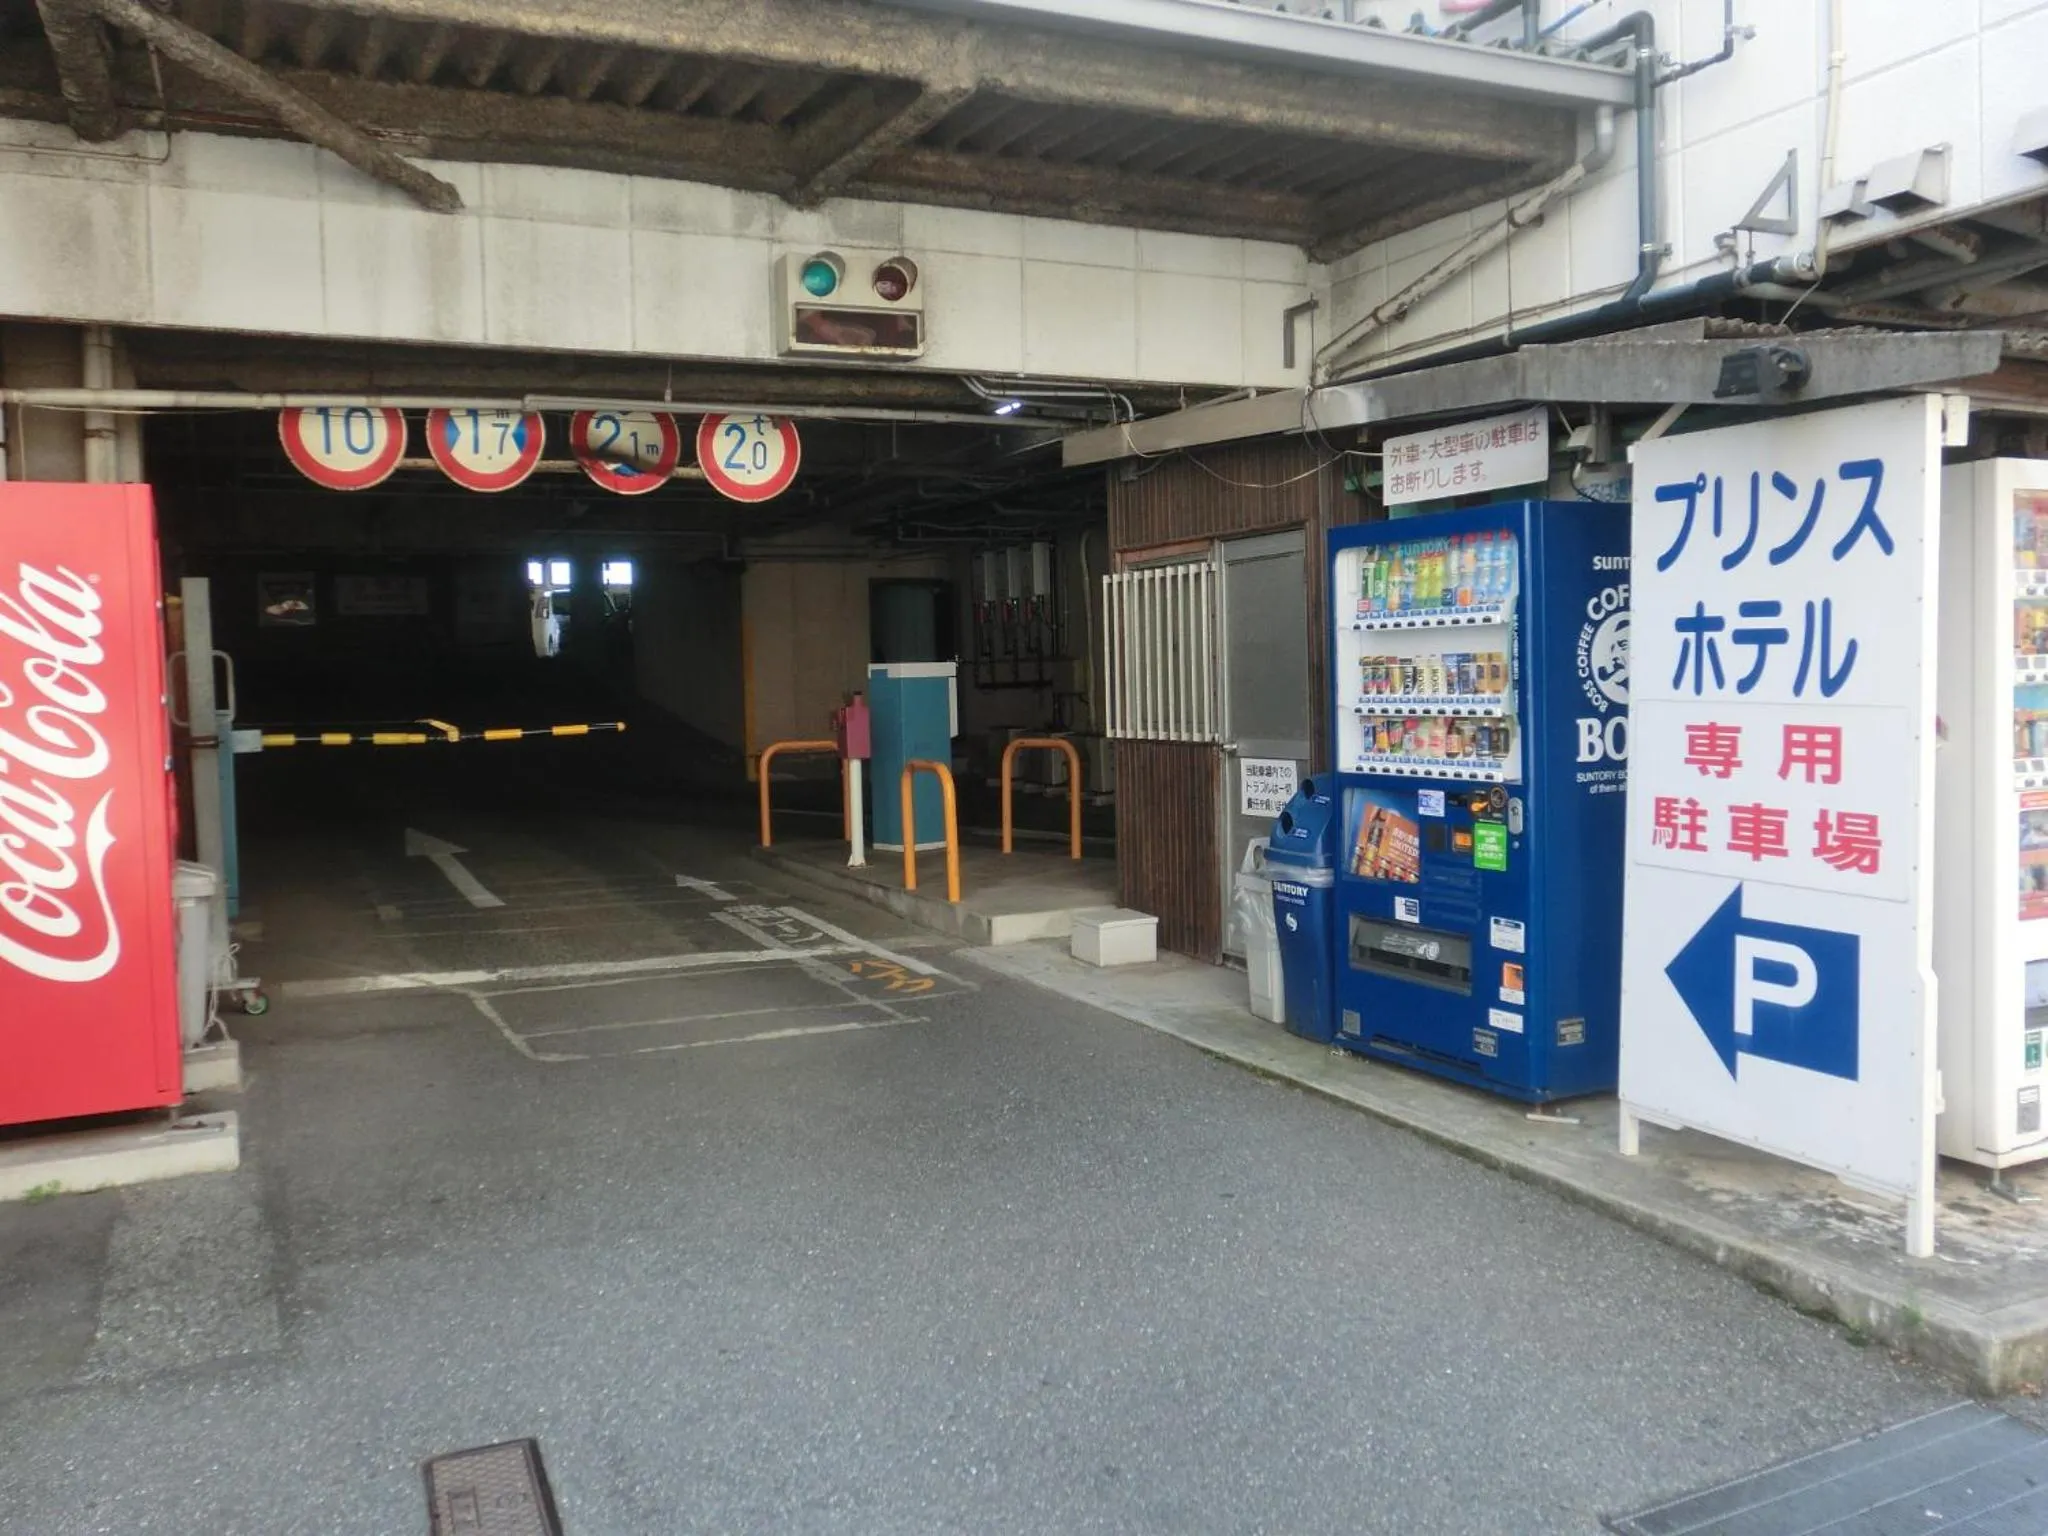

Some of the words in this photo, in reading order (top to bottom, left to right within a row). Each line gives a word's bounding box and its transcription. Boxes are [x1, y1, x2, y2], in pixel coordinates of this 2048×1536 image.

[317, 407, 375, 455] 10
[1655, 458, 1894, 572] プリンス
[1577, 622, 1595, 677] COFFEE
[1672, 598, 1857, 697] ホテル
[1583, 680, 1608, 713] BOSS
[1576, 771, 1616, 783] SUNTORY
[1684, 722, 1843, 785] 専用
[1652, 797, 1882, 875] 駐車場
[1734, 934, 1818, 1036] P
